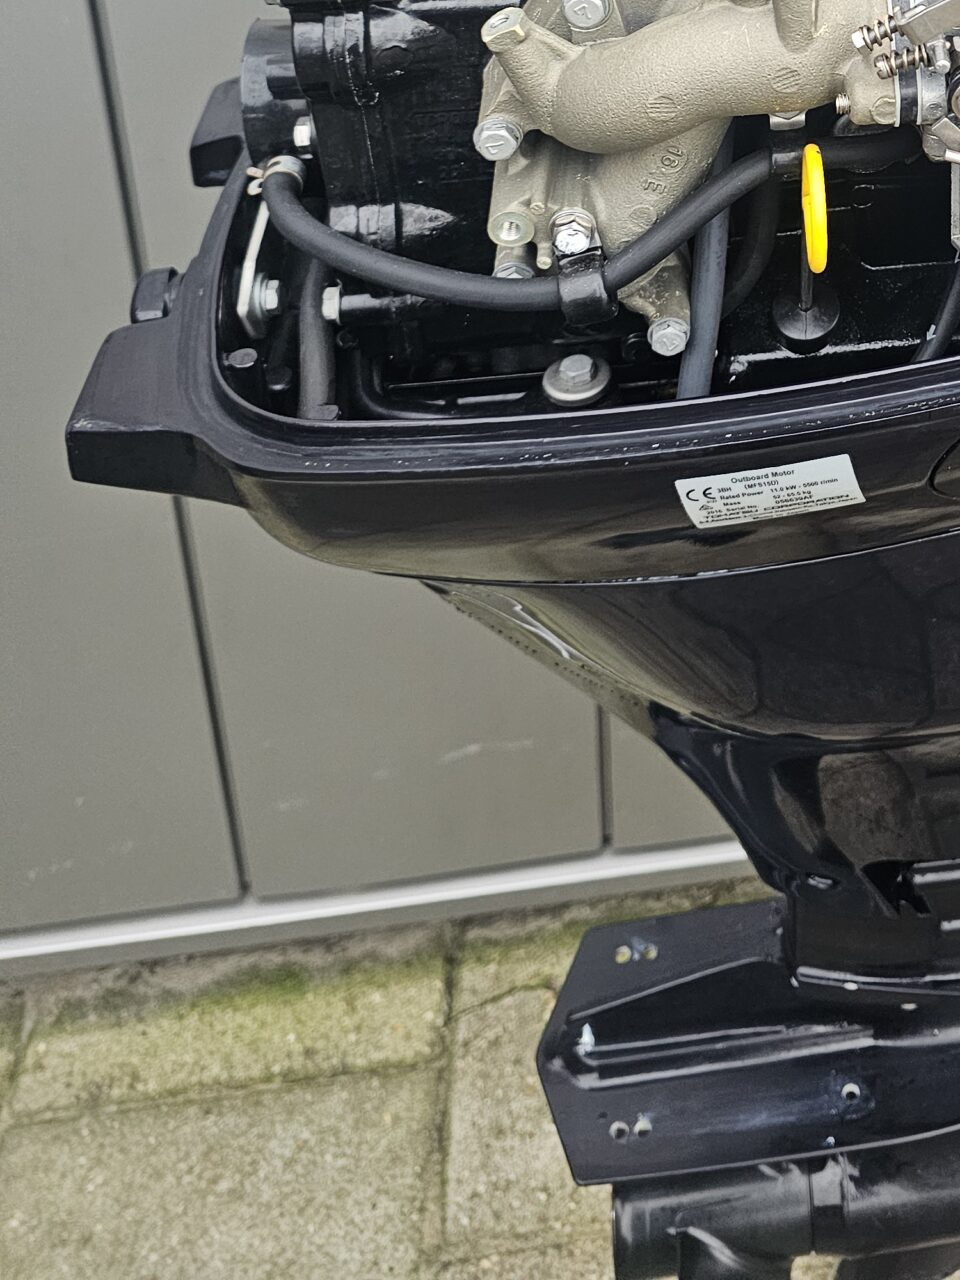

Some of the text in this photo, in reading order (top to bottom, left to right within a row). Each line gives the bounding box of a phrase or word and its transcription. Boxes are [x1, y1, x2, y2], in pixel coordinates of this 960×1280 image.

[730, 469, 795, 484] Outboard Motor
[719, 492, 741, 501] Rated
[742, 490, 764, 498] Power
